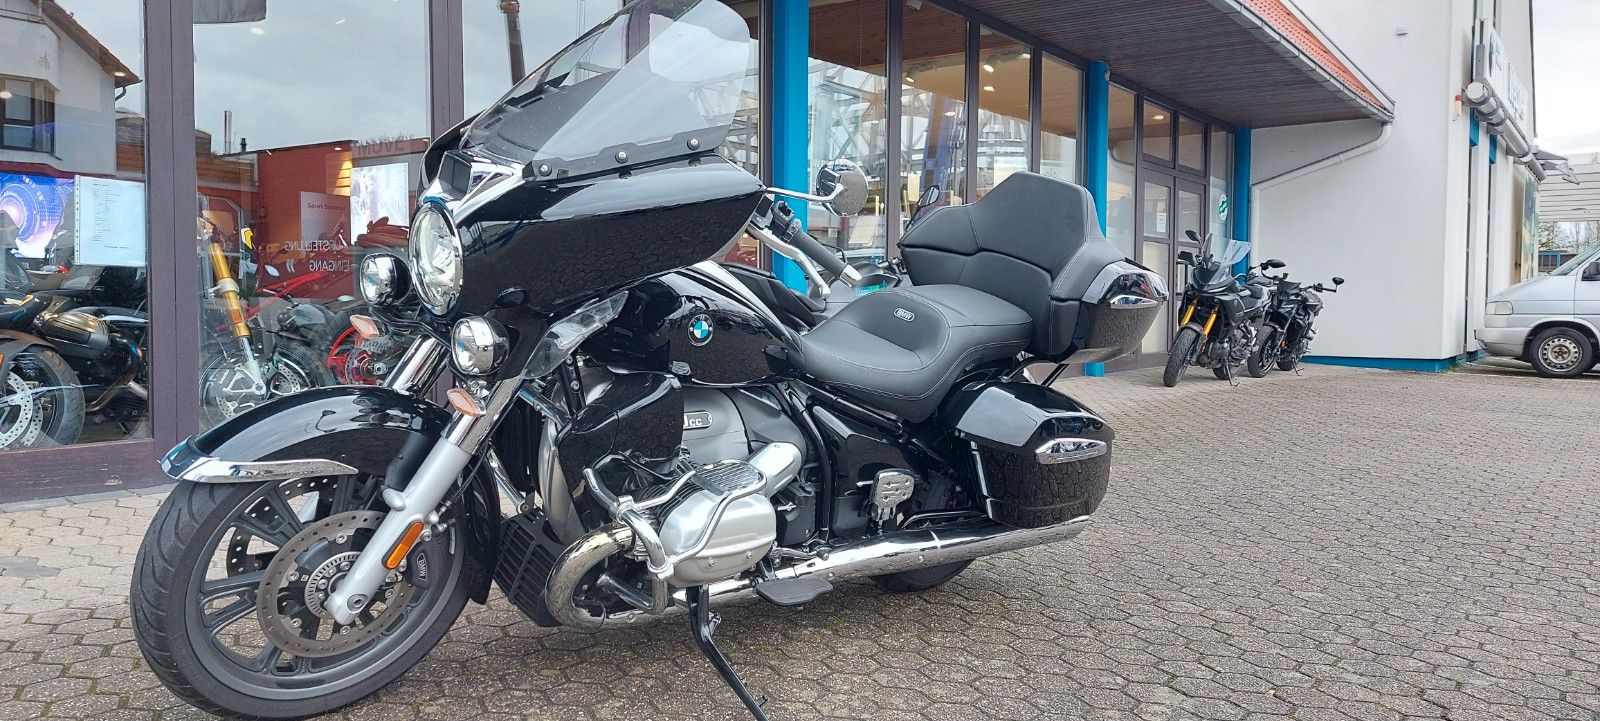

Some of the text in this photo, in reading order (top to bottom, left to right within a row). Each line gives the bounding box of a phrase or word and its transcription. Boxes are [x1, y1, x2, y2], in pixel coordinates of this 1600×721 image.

[307, 202, 323, 210] Sport
[896, 309, 913, 320] BMW
[418, 560, 427, 576] BMW
